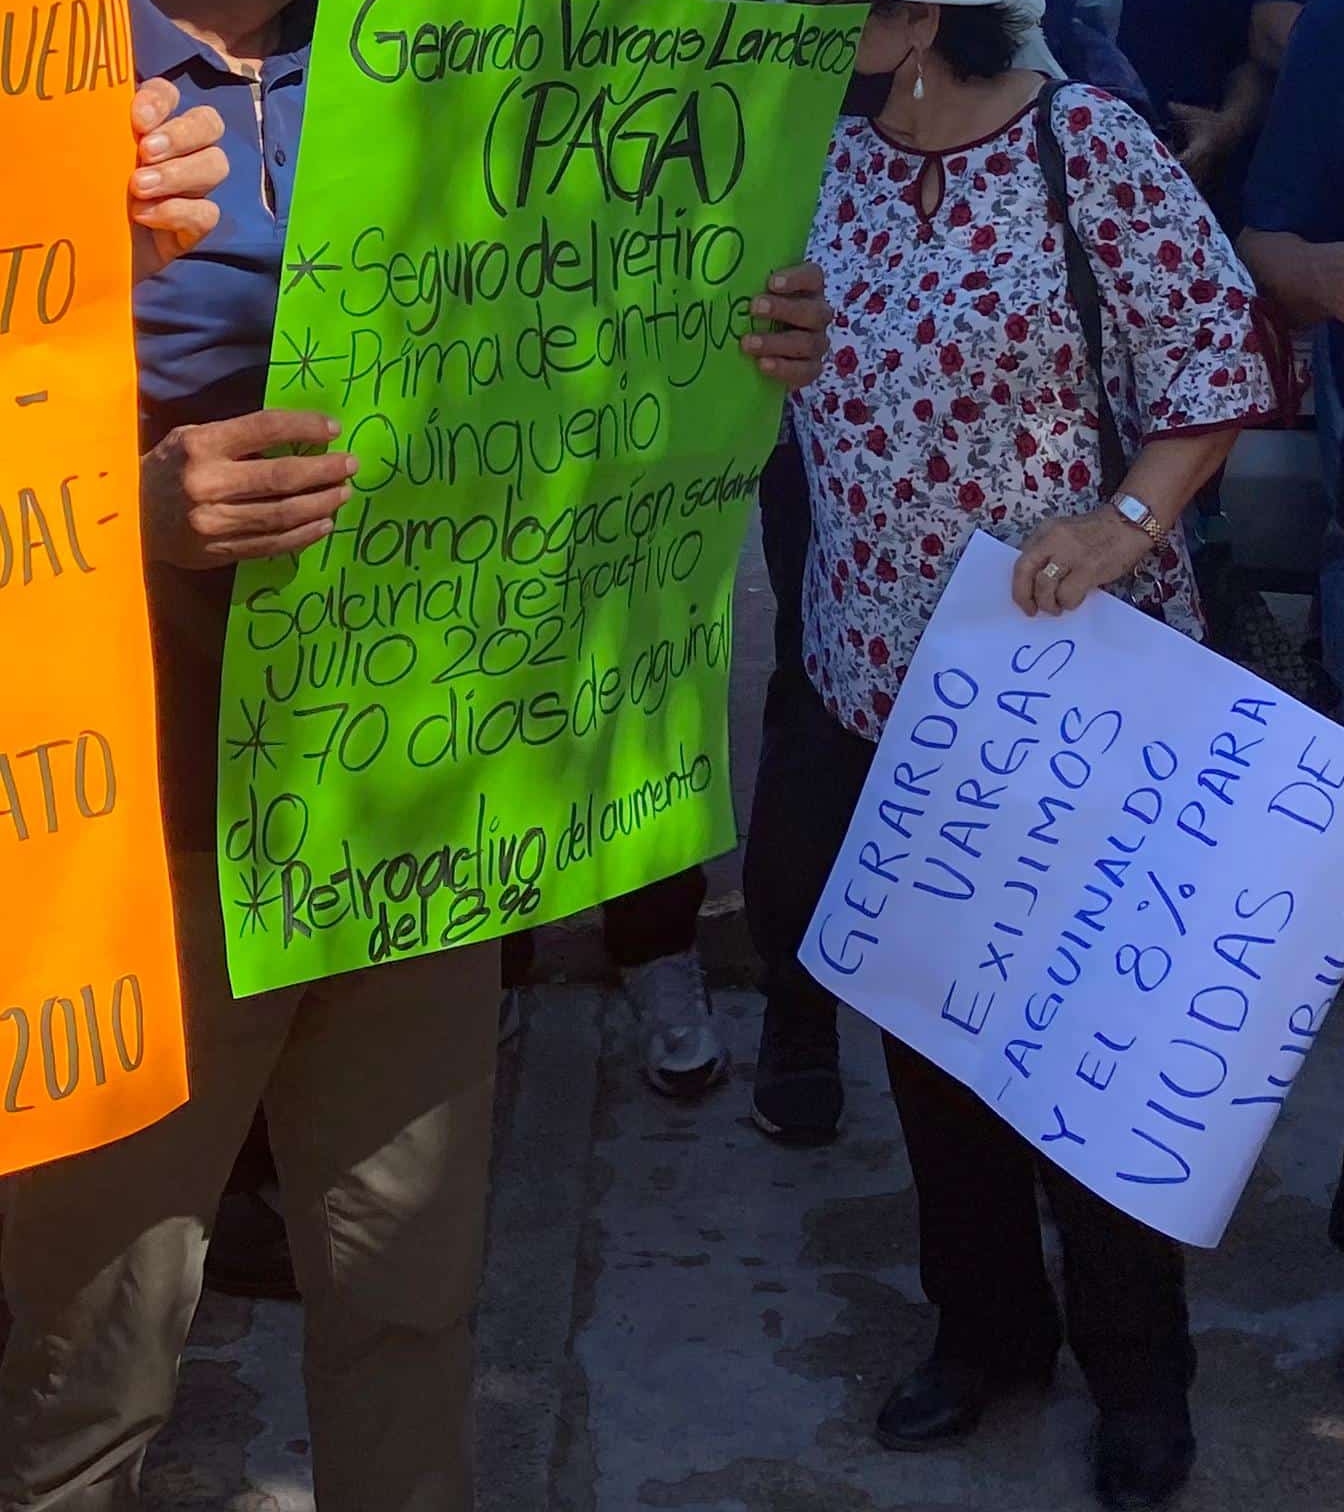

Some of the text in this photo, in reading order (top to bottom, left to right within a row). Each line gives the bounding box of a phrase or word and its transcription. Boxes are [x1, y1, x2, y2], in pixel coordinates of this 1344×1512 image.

[704, 0, 862, 74] Landeros
[482, 78, 747, 217] (PAGA)
[341, 204, 746, 335] Seguro del retiro
[515, 301, 597, 389] de
[246, 559, 481, 652] Salarial
[430, 605, 590, 686] 2021
[293, 702, 390, 785] 70
[406, 687, 572, 769] dias
[572, 652, 626, 738] de
[912, 637, 1076, 902] VARGAS
[280, 742, 713, 950] Retroactivo del aumento
[818, 667, 980, 976] GERARDO
[941, 706, 1123, 1036] EXIJIMOS
[367, 896, 429, 965] del
[1041, 1104, 1087, 1147] Y
[1076, 1030, 1138, 1092] EL
[1176, 695, 1279, 847] PARA
[1, 974, 146, 1113] 2010
[1115, 886, 1297, 1185] VIUDAS
